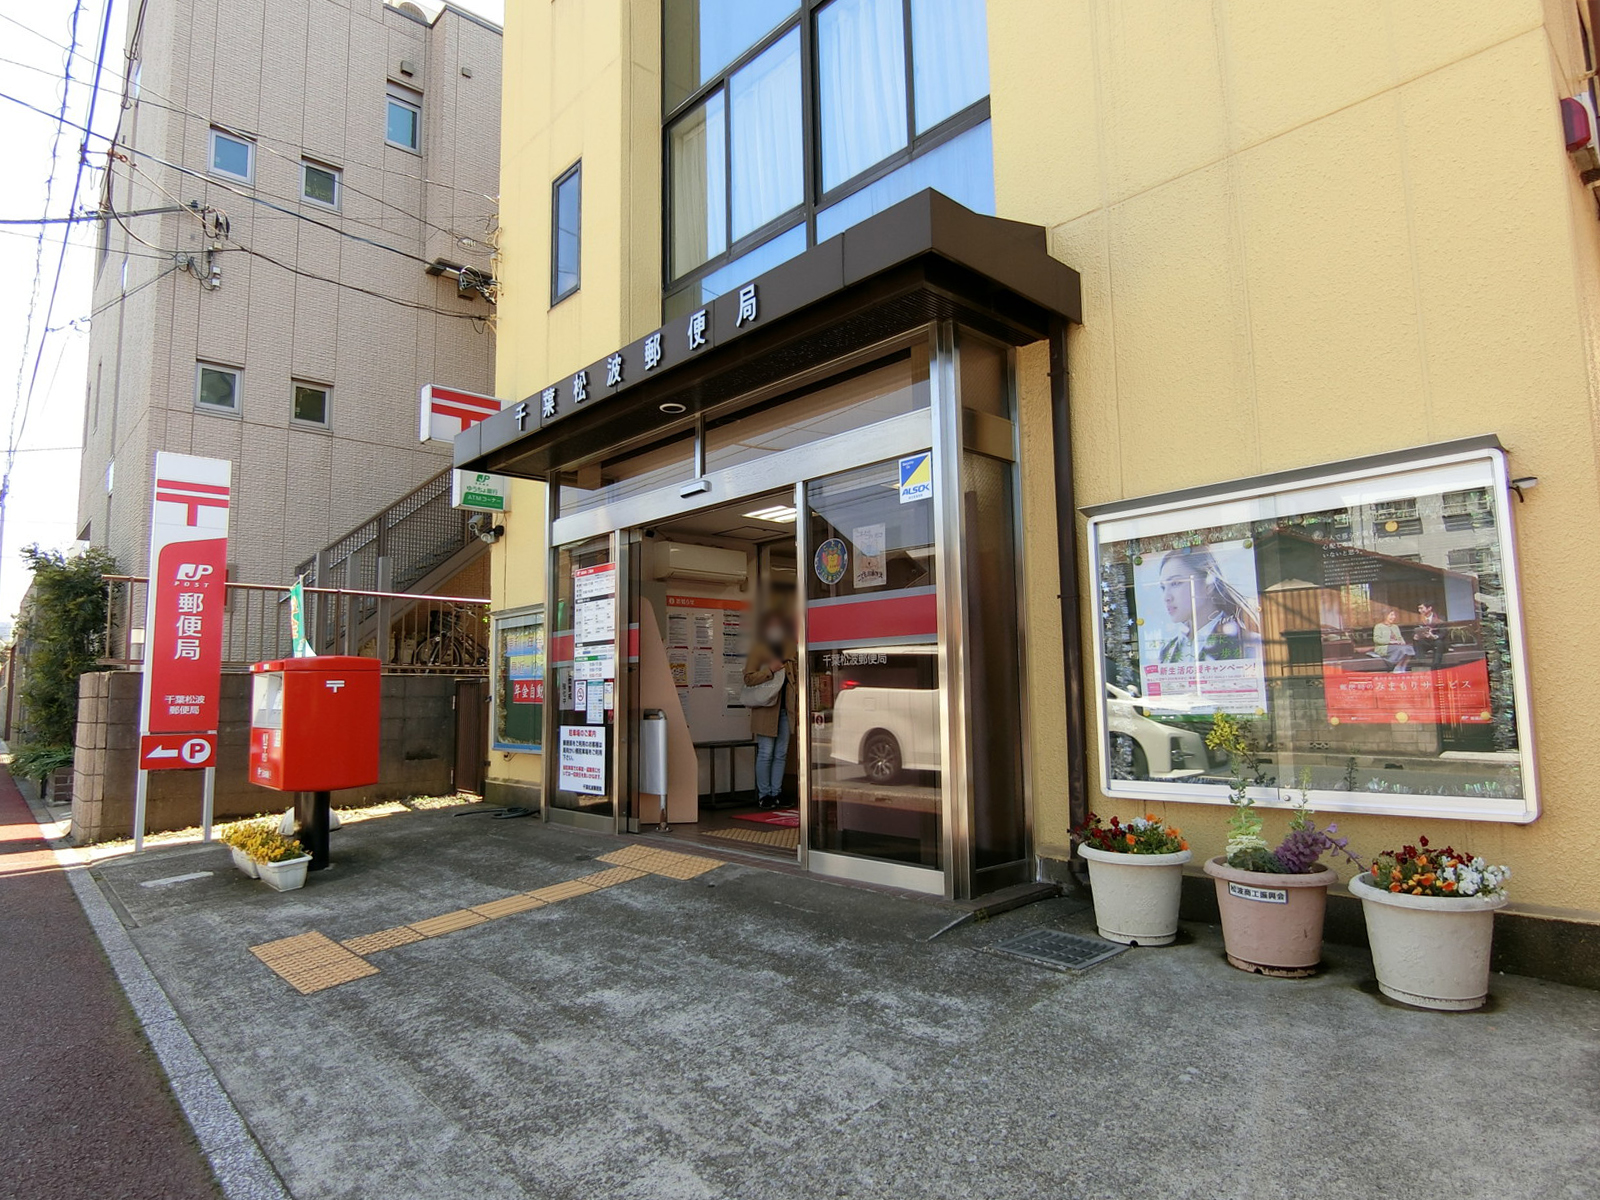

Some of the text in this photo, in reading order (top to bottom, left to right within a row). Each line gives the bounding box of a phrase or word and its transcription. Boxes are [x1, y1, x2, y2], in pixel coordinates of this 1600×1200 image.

[514, 283, 758, 432] 千葉松波郵便局
[902, 482, 930, 496] ALSOK
[174, 592, 204, 661] 郵便局
[822, 653, 888, 667] 千葉松波郵便局
[165, 695, 206, 705] 千葉松波
[169, 705, 200, 715] 郵便局
[1230, 884, 1285, 900] 松波商工振興会
